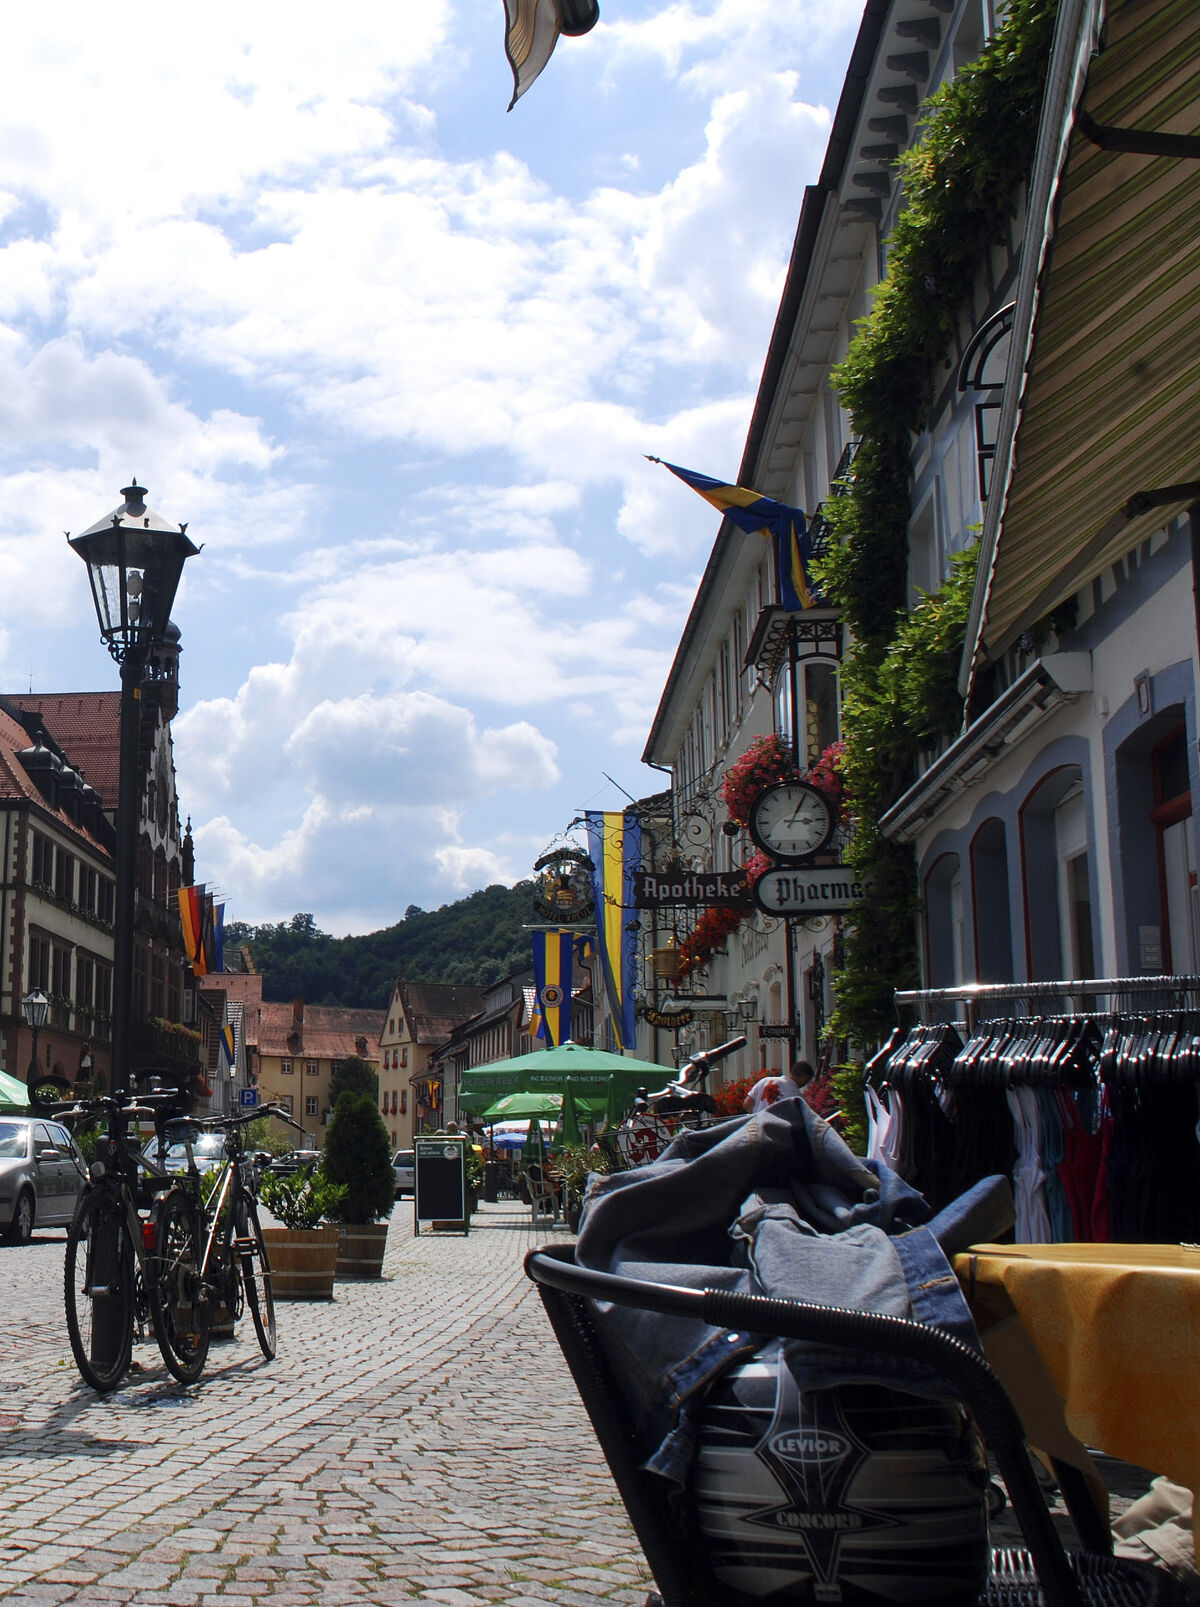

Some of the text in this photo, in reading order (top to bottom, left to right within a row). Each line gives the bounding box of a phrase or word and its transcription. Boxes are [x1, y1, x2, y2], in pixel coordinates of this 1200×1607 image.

[642, 876, 740, 900] Apotheke
[537, 905, 561, 921] HOTEL
[762, 1026, 795, 1036] Eingang
[244, 1091, 254, 1105] P
[777, 1439, 841, 1453] LEVIOR
[775, 1511, 863, 1529] CONCORD
